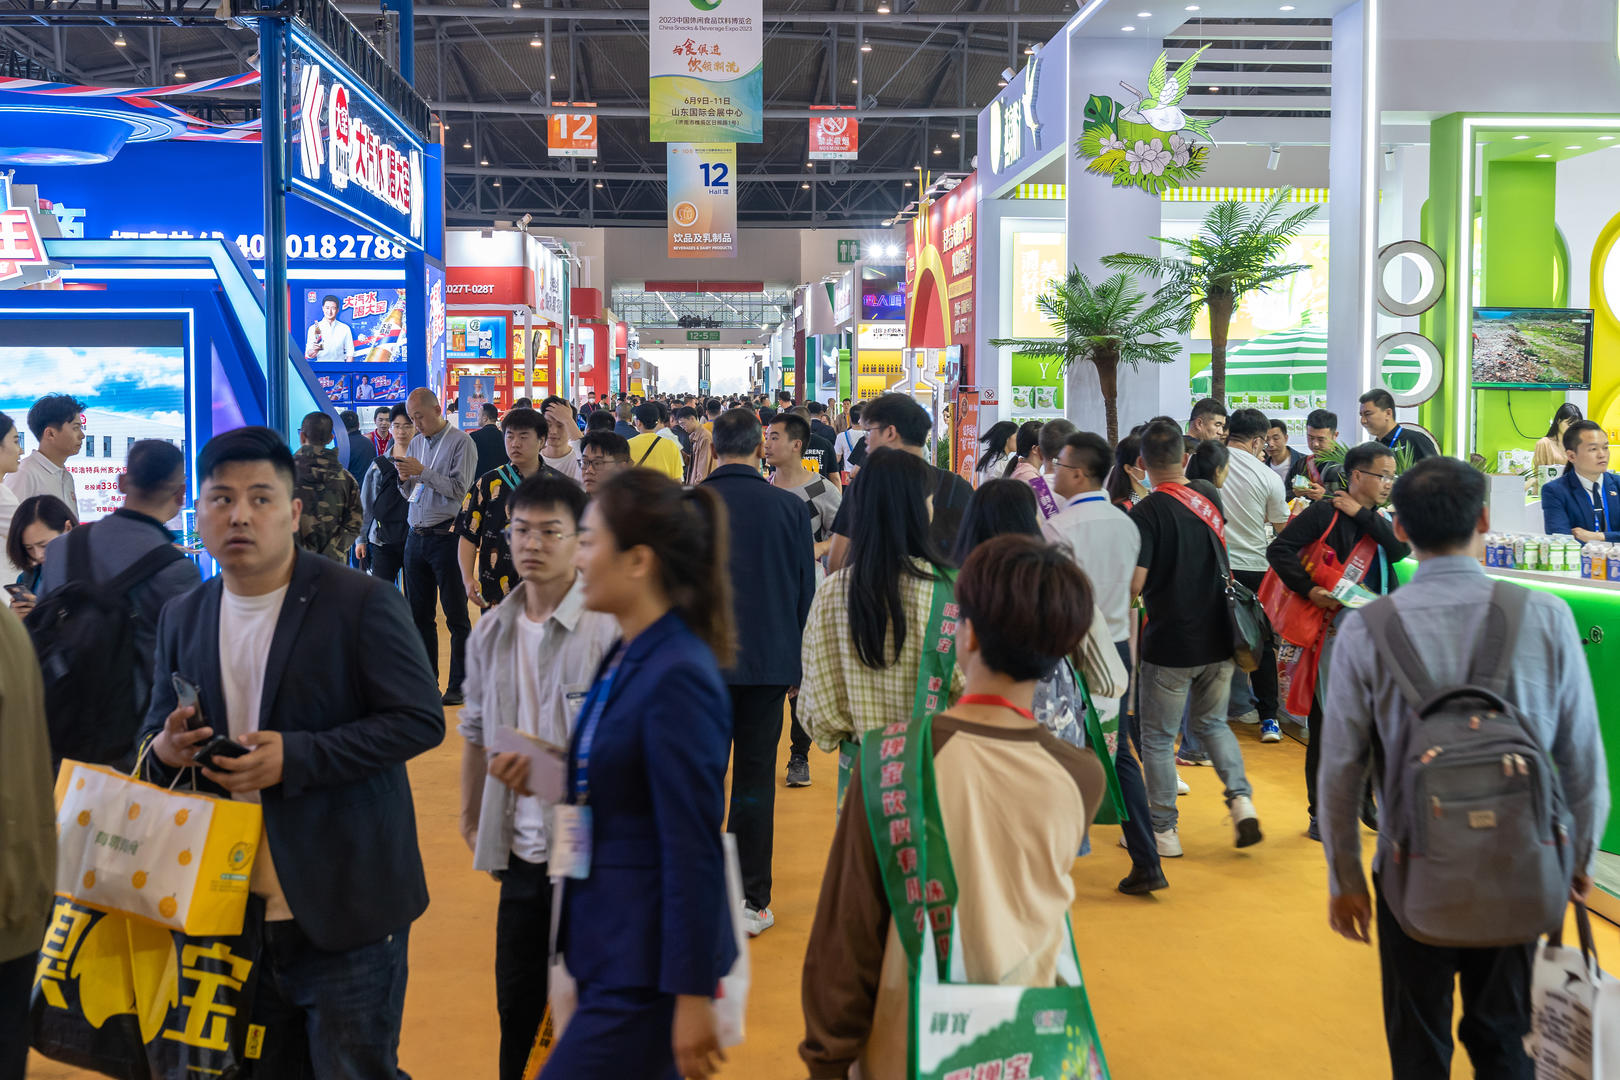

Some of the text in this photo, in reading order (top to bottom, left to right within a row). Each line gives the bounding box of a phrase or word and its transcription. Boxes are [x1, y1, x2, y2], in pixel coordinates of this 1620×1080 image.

[684, 97, 730, 105] 6月9日-11日
[672, 108, 743, 118] 山东国际会展中心
[554, 114, 592, 140] 12
[699, 162, 728, 186] 12
[674, 233, 732, 243] 饮品及乳制品
[446, 285, 494, 294] 027T-028T
[344, 292, 376, 308] 大汽水
